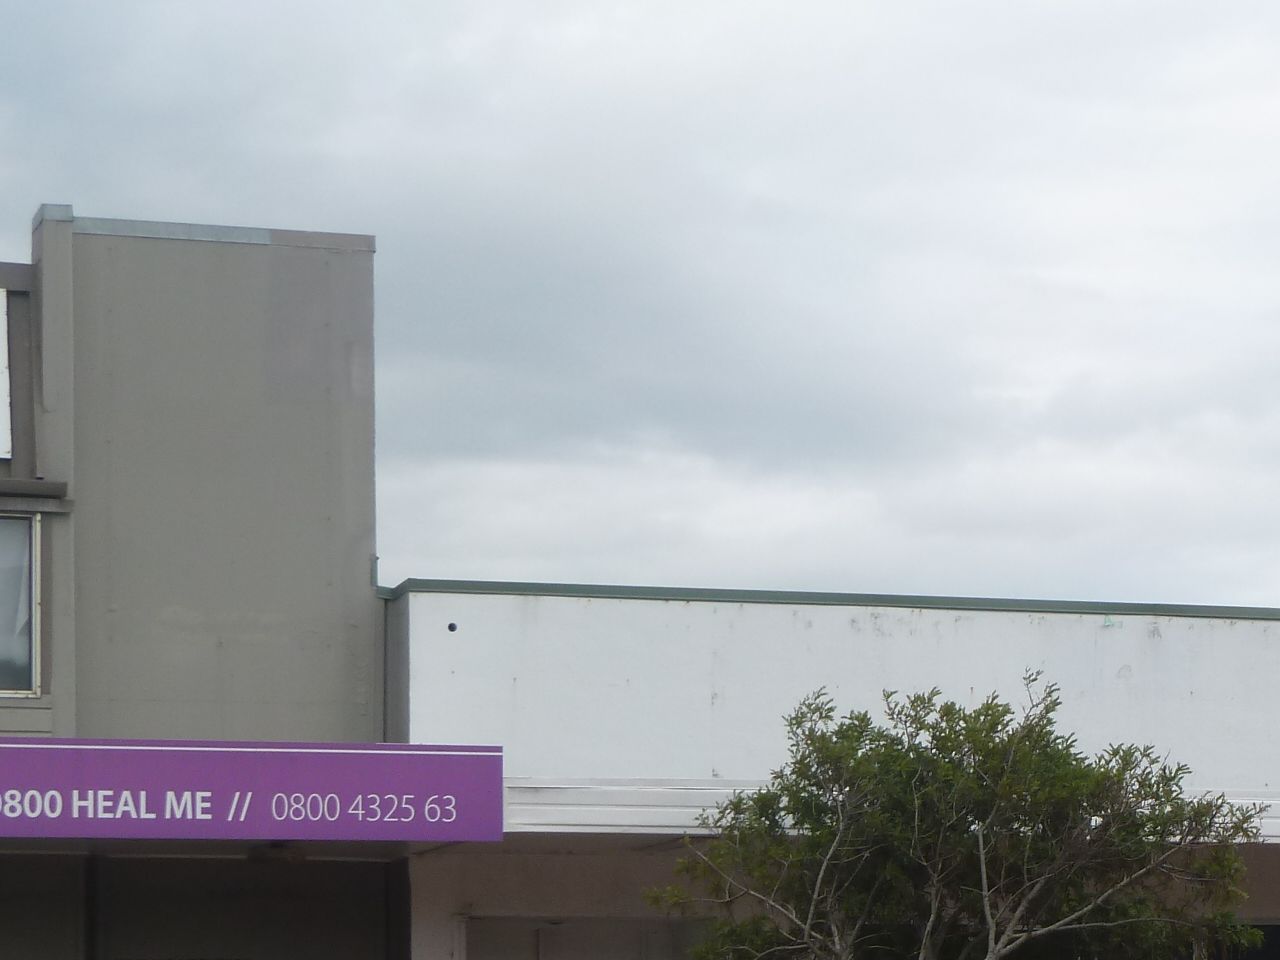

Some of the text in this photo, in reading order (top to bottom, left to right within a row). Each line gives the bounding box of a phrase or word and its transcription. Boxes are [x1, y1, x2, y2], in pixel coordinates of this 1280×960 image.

[0, 790, 63, 819] 800
[72, 790, 156, 819] HEAL
[165, 791, 212, 820] ME
[271, 793, 340, 822] 0800
[348, 794, 415, 823] 4325
[424, 795, 457, 823] 63
